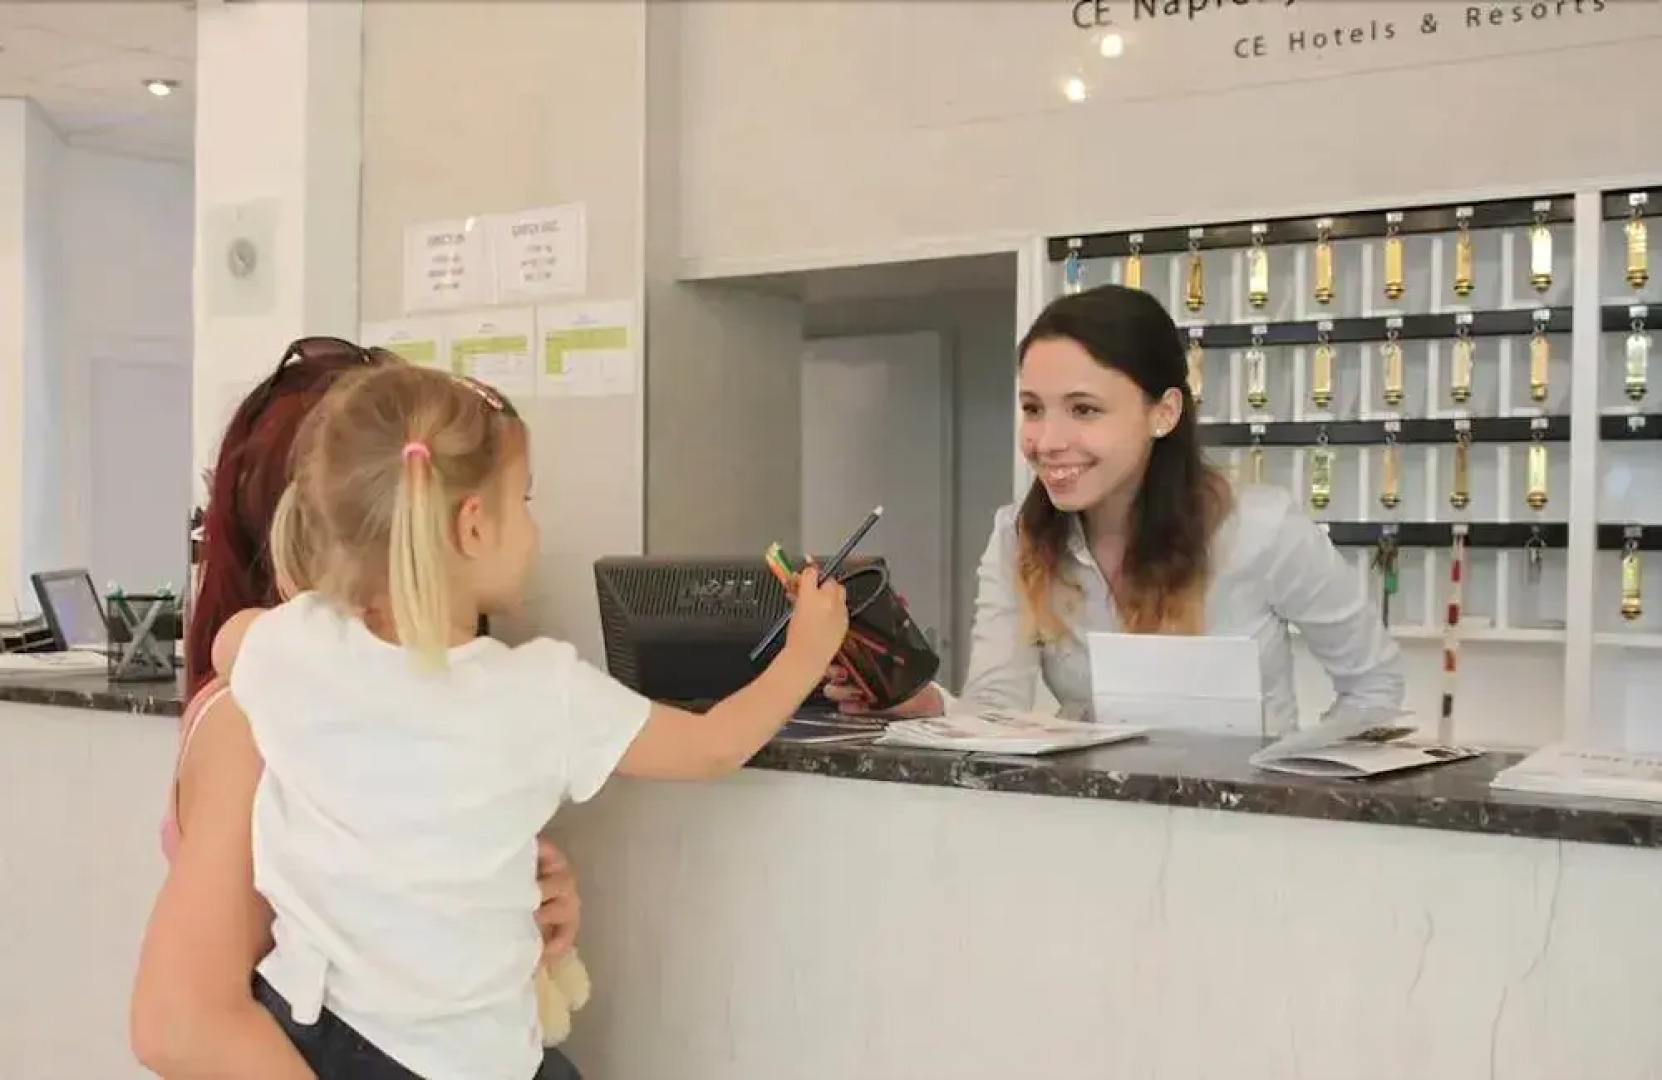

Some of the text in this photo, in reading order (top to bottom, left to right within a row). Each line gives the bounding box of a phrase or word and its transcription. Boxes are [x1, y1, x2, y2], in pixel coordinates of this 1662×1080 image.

[1072, 0, 1112, 29] CE
[1234, 0, 1605, 58] CE Hotels & Resorts
